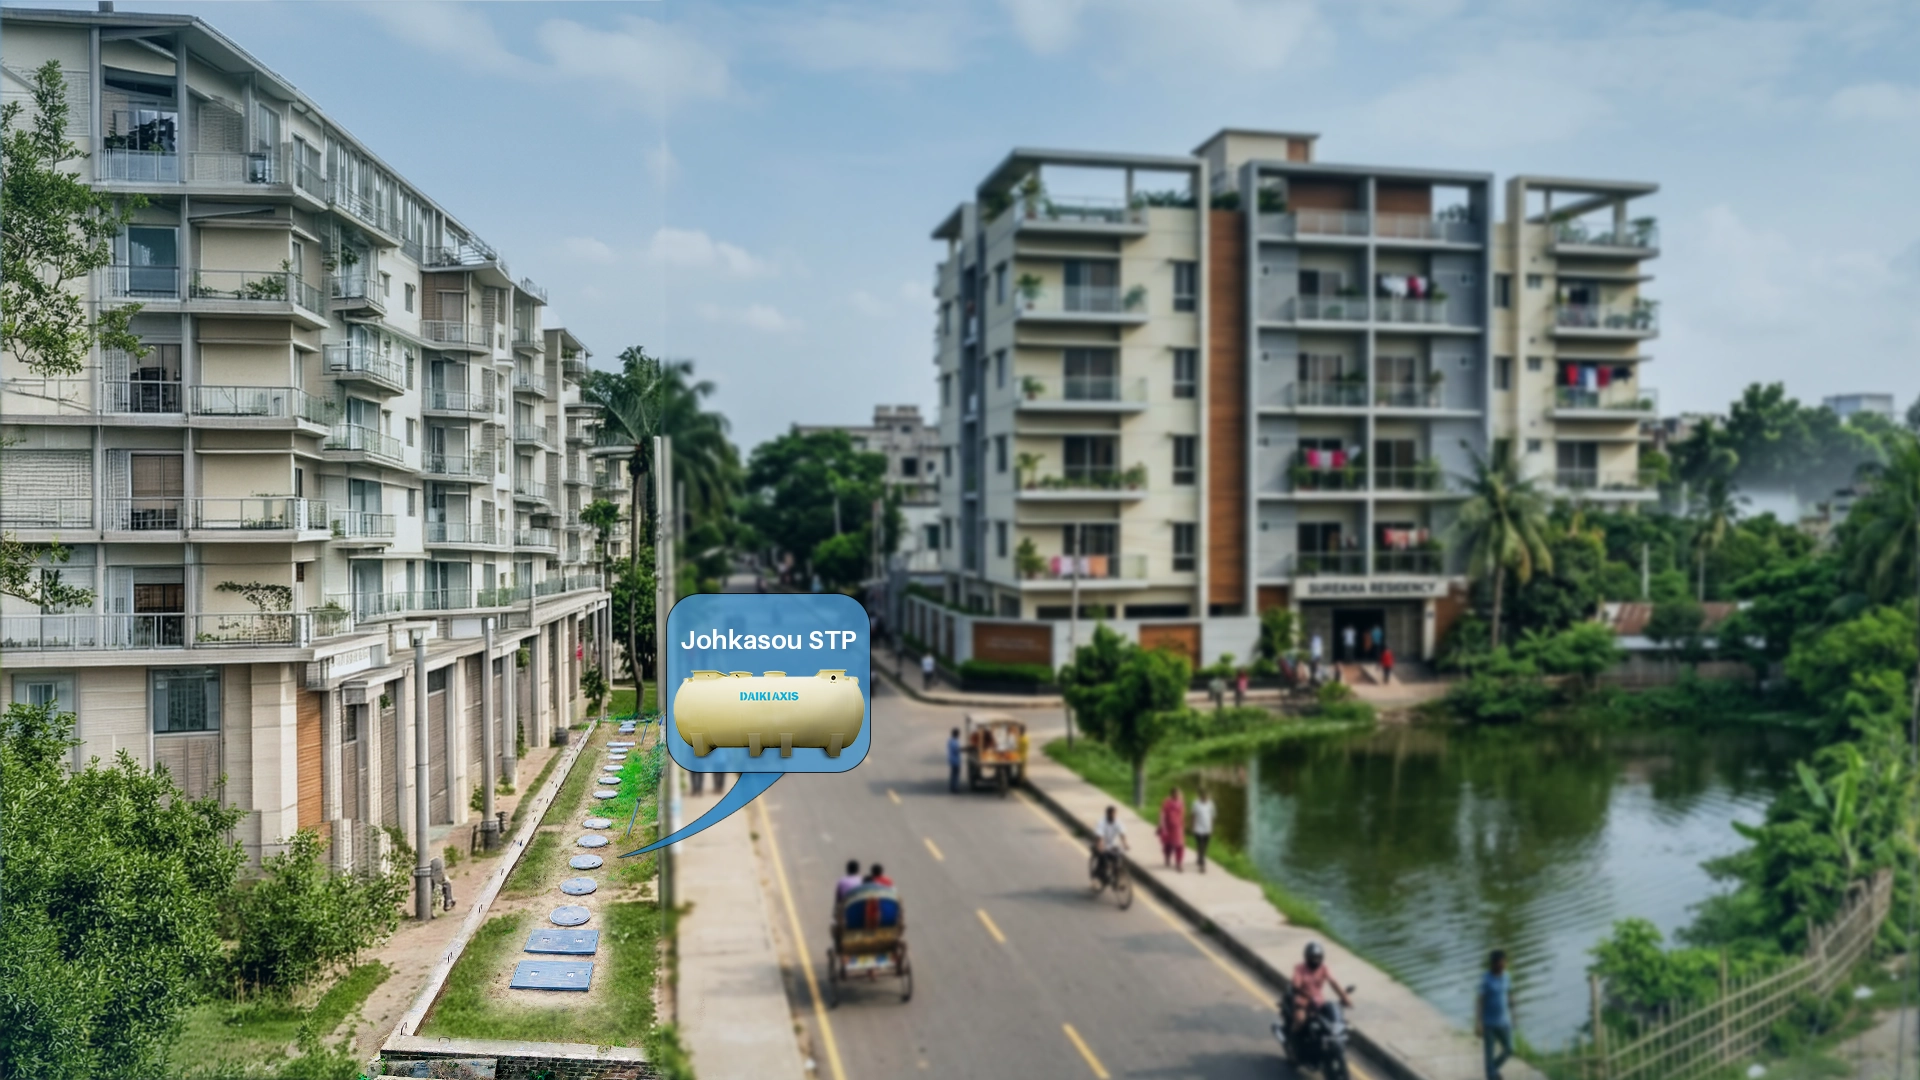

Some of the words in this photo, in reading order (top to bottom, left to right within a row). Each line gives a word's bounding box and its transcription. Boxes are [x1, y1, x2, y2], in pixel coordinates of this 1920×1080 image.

[1370, 582, 1436, 593] RESIDENCY
[739, 691, 771, 701] DAIKI
[772, 691, 799, 701] AXIS
